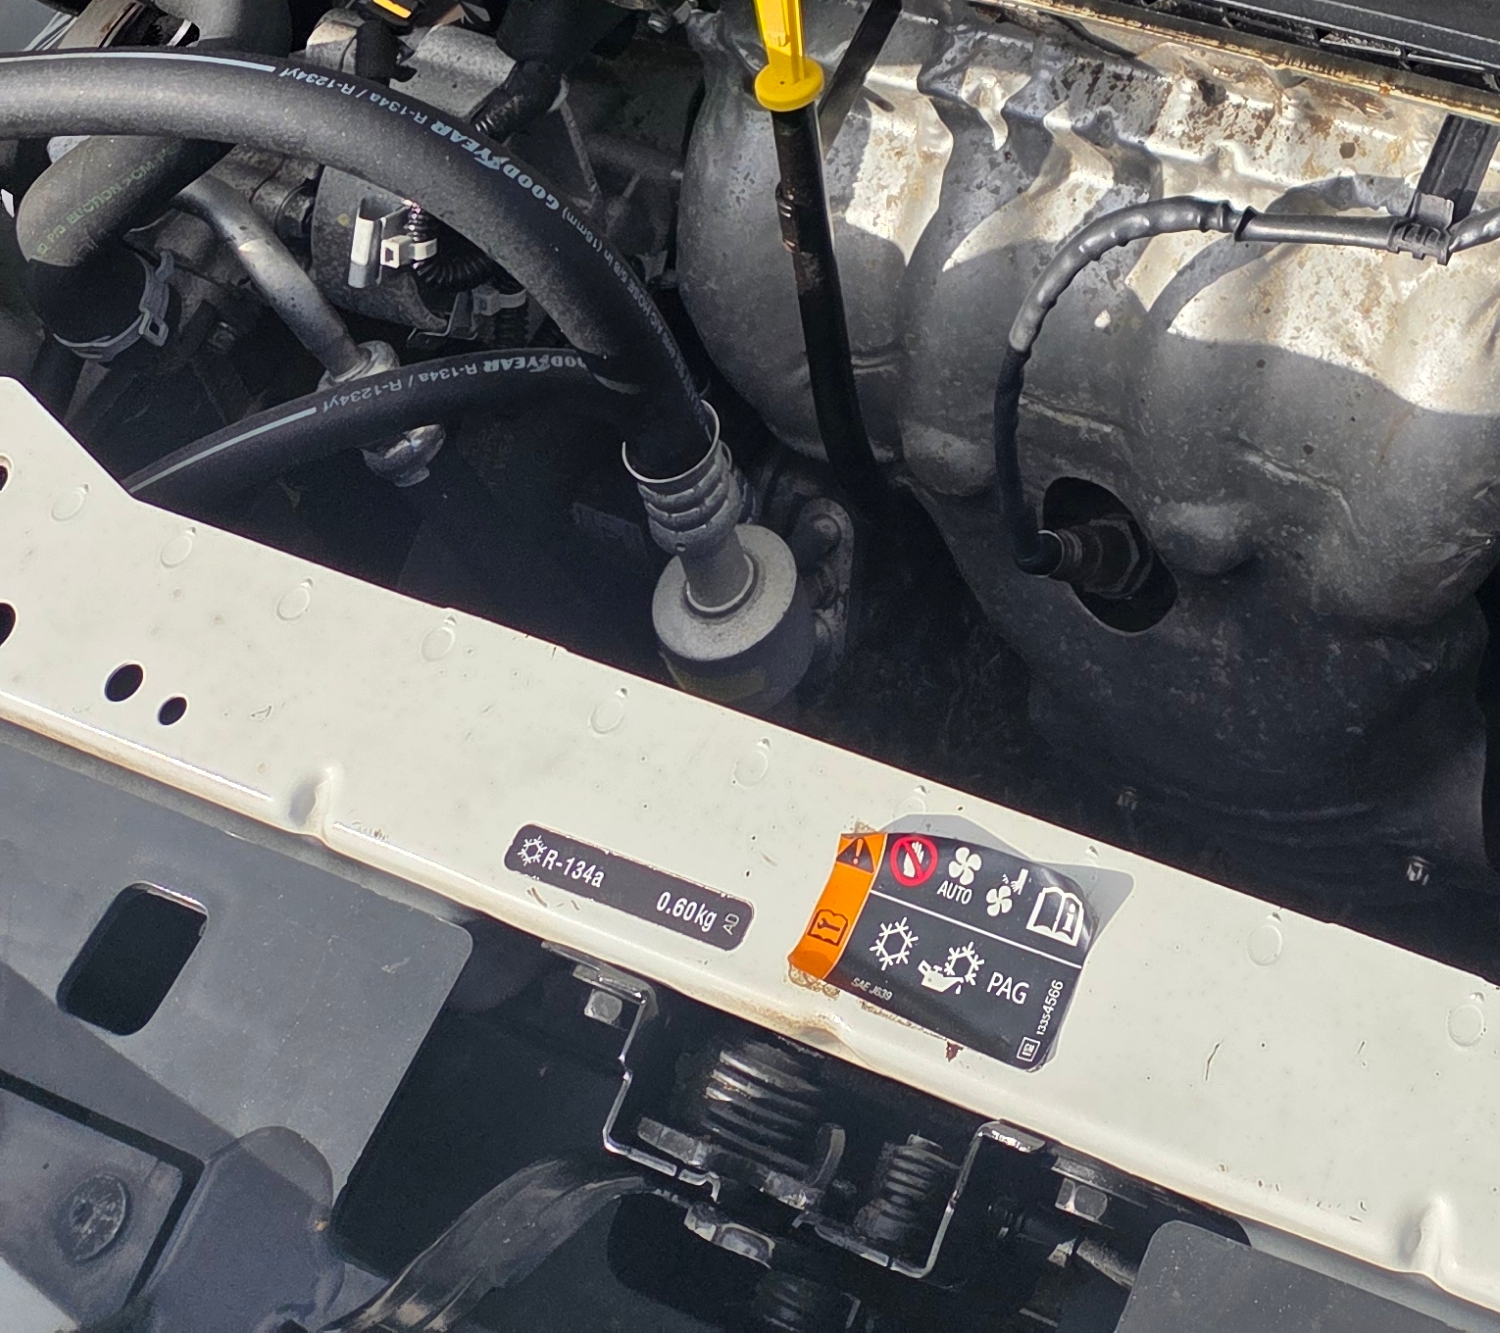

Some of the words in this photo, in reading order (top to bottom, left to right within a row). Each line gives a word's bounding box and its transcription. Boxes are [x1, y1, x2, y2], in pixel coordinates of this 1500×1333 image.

[280, 67, 356, 96] R-1234yf
[369, 92, 428, 125] R-134a
[430, 120, 559, 210] GOODYEAR
[417, 363, 478, 381] R-134a
[322, 378, 402, 413] R-1234yf
[541, 847, 607, 891] R-134a
[656, 889, 718, 933] 0.60kg
[937, 880, 973, 905] AUTO
[851, 976, 871, 992] SAE
[869, 984, 893, 1002] J639
[986, 971, 1030, 1005] PAG
[1036, 979, 1065, 1036] 13354566
